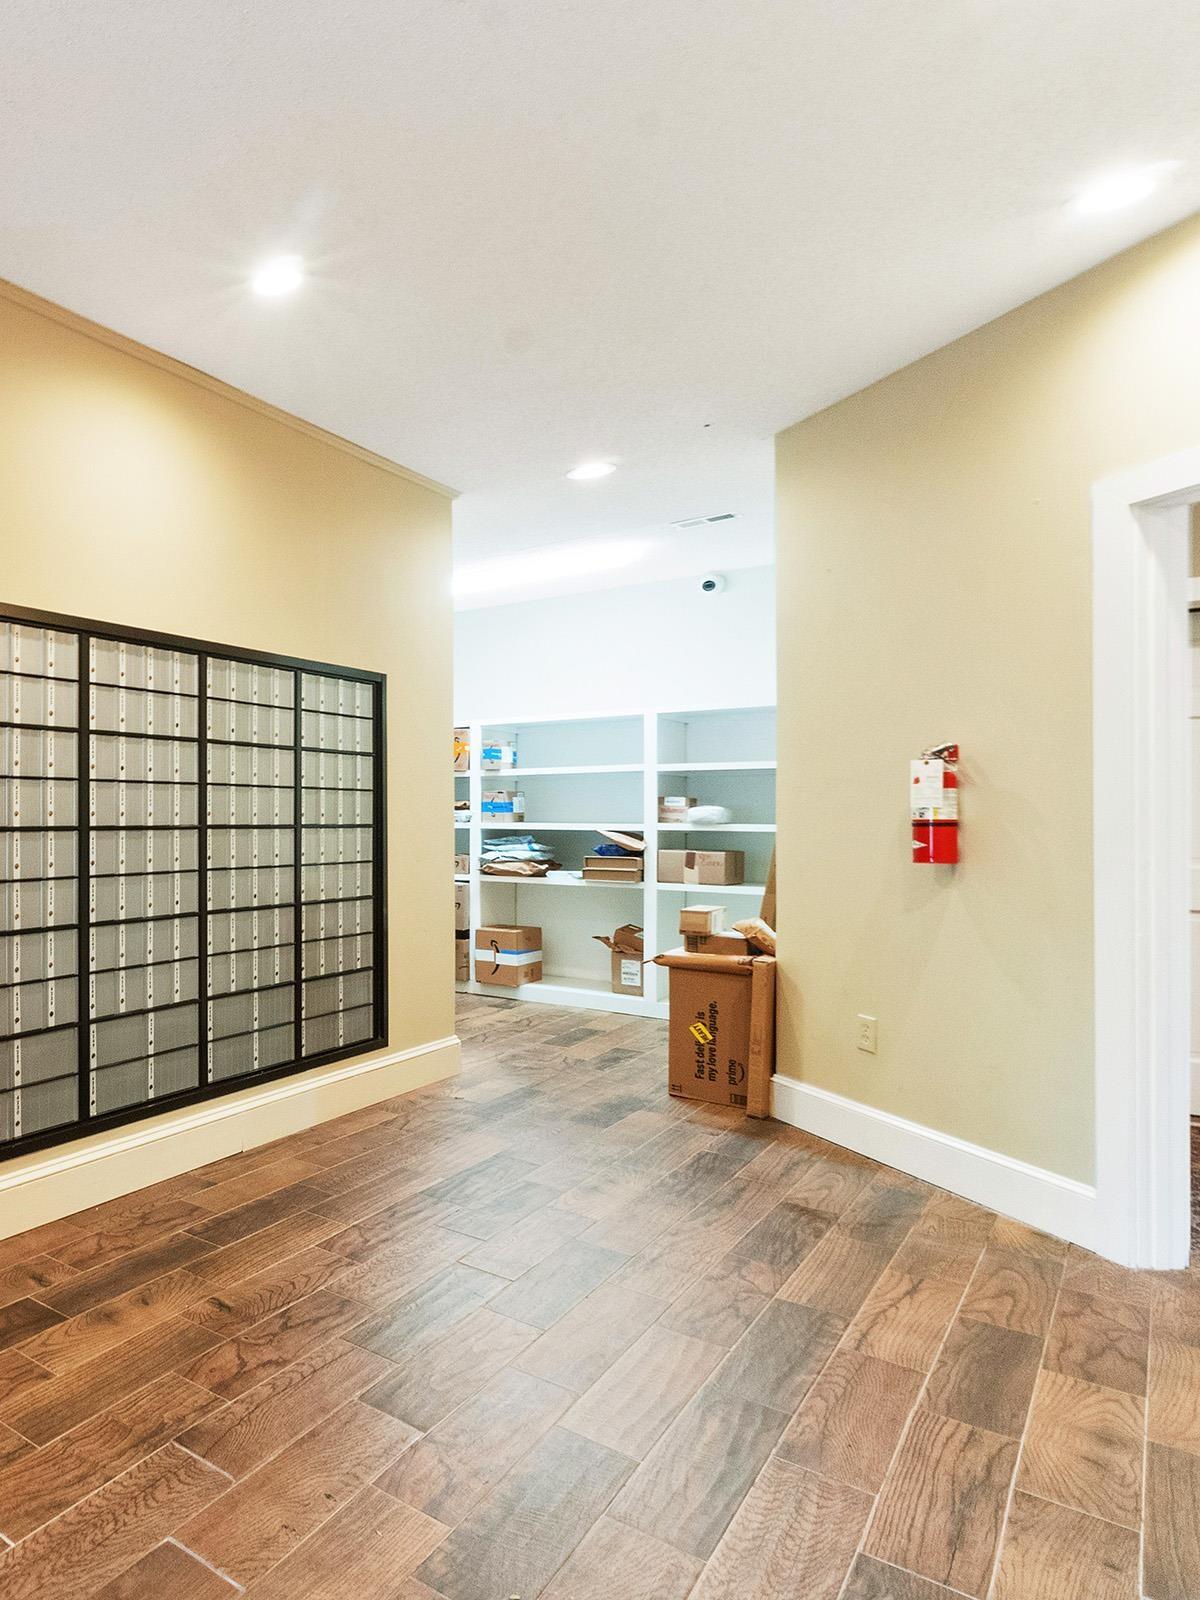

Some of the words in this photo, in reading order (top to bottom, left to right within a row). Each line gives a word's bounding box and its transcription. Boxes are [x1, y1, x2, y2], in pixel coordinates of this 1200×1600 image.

[695, 1011, 705, 1020] is
[706, 1047, 717, 1067] love
[695, 1060, 705, 1080] Fast
[708, 1067, 719, 1082] my
[726, 1059, 738, 1086] prime
